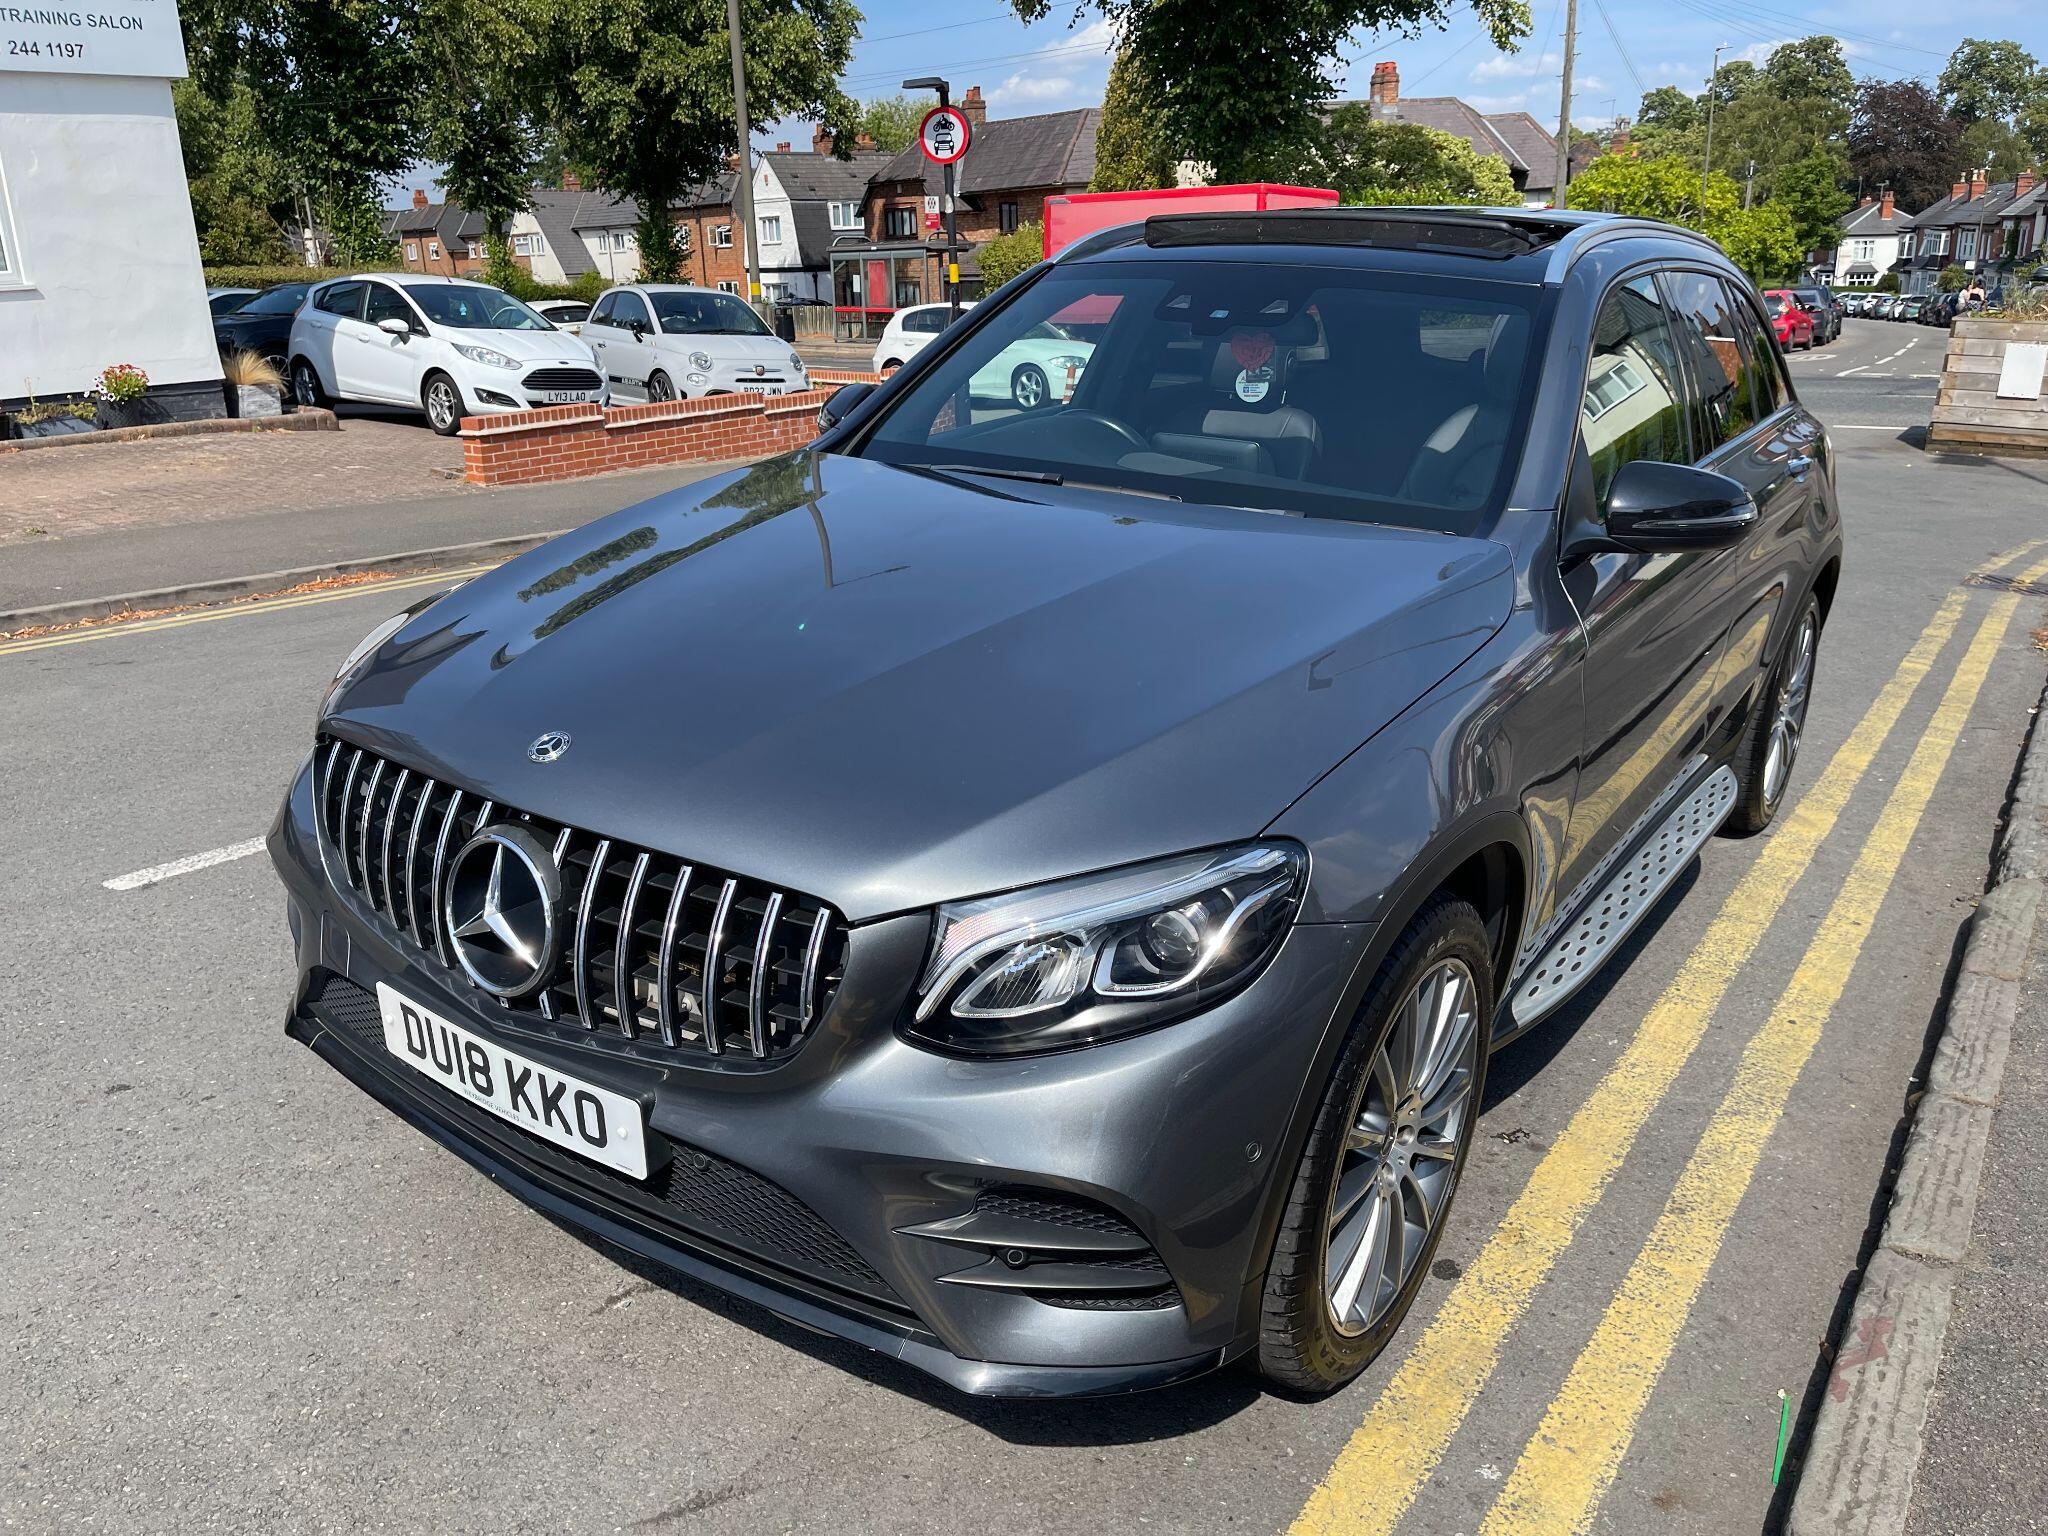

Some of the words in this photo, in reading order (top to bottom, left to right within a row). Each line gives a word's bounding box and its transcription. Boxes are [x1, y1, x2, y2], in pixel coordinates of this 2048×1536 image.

[0, 8, 82, 26] TRAINING
[87, 14, 143, 30] SALON
[8, 40, 40, 56] 244
[46, 42, 84, 58] 1197
[621, 376, 643, 387] ABARTH
[548, 391, 568, 402] LY13
[569, 392, 586, 402] LAO
[767, 387, 782, 396] JWN
[399, 1002, 494, 1098] DU18
[503, 1058, 608, 1149] KKO
